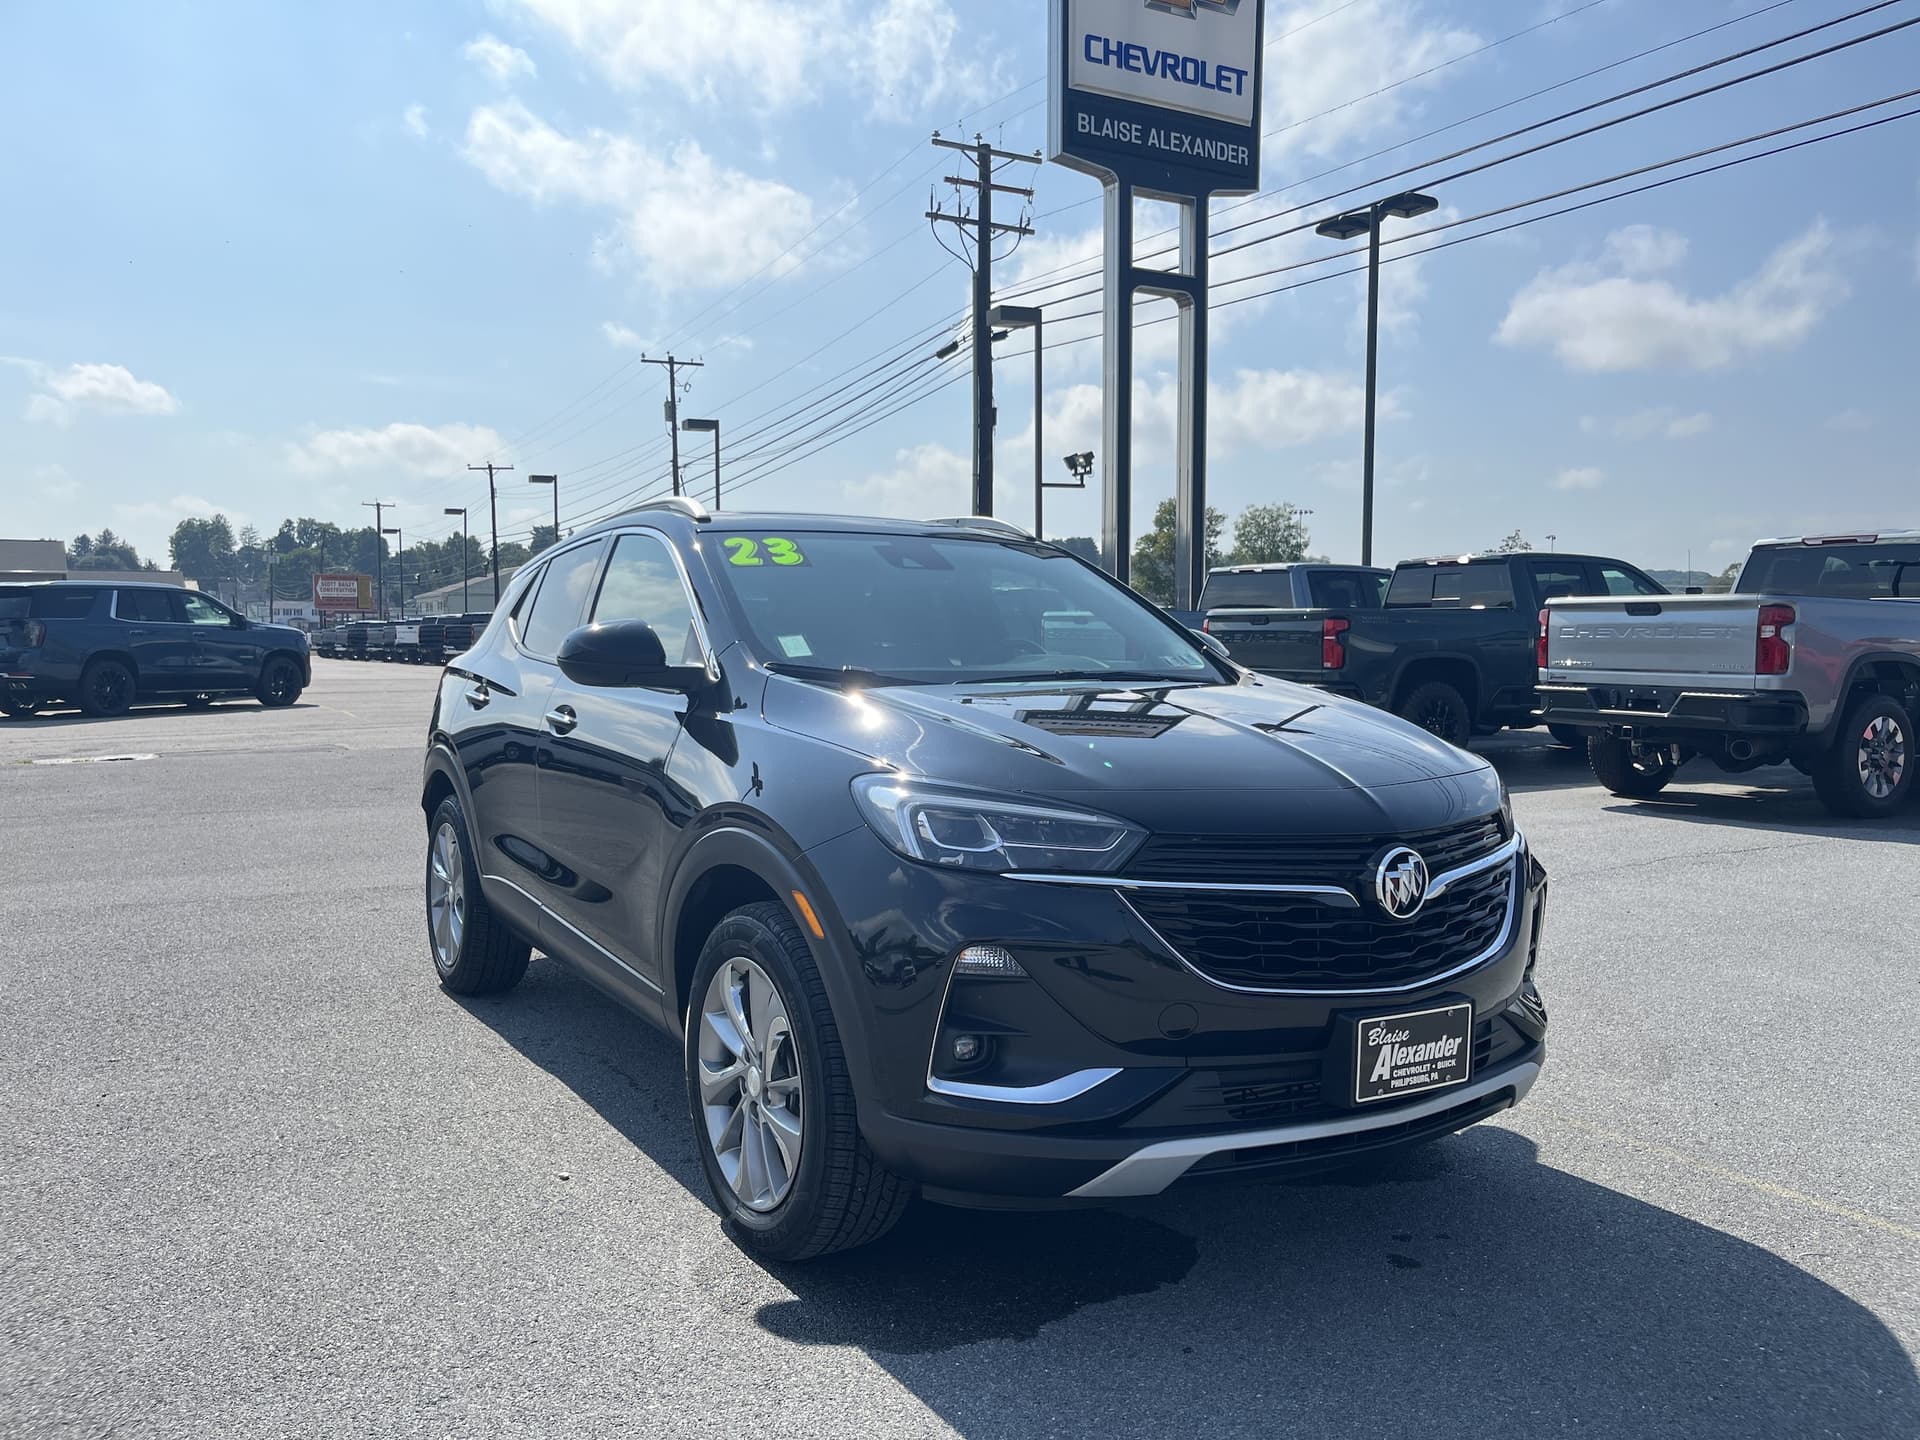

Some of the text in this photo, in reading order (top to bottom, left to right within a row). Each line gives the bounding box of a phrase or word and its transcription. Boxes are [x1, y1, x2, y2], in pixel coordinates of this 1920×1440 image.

[1084, 34, 1248, 96] CHEVROLET
[1077, 112, 1249, 166] BLAISE ALEXANDER
[723, 537, 804, 566] 23
[1558, 625, 1741, 639] CHEVROLET
[1368, 1028, 1410, 1046] Blaise
[1369, 1034, 1462, 1082] Alexander
[1392, 1059, 1456, 1077] CHEVROLET BUICK
[1430, 1072, 1439, 1081] PA
